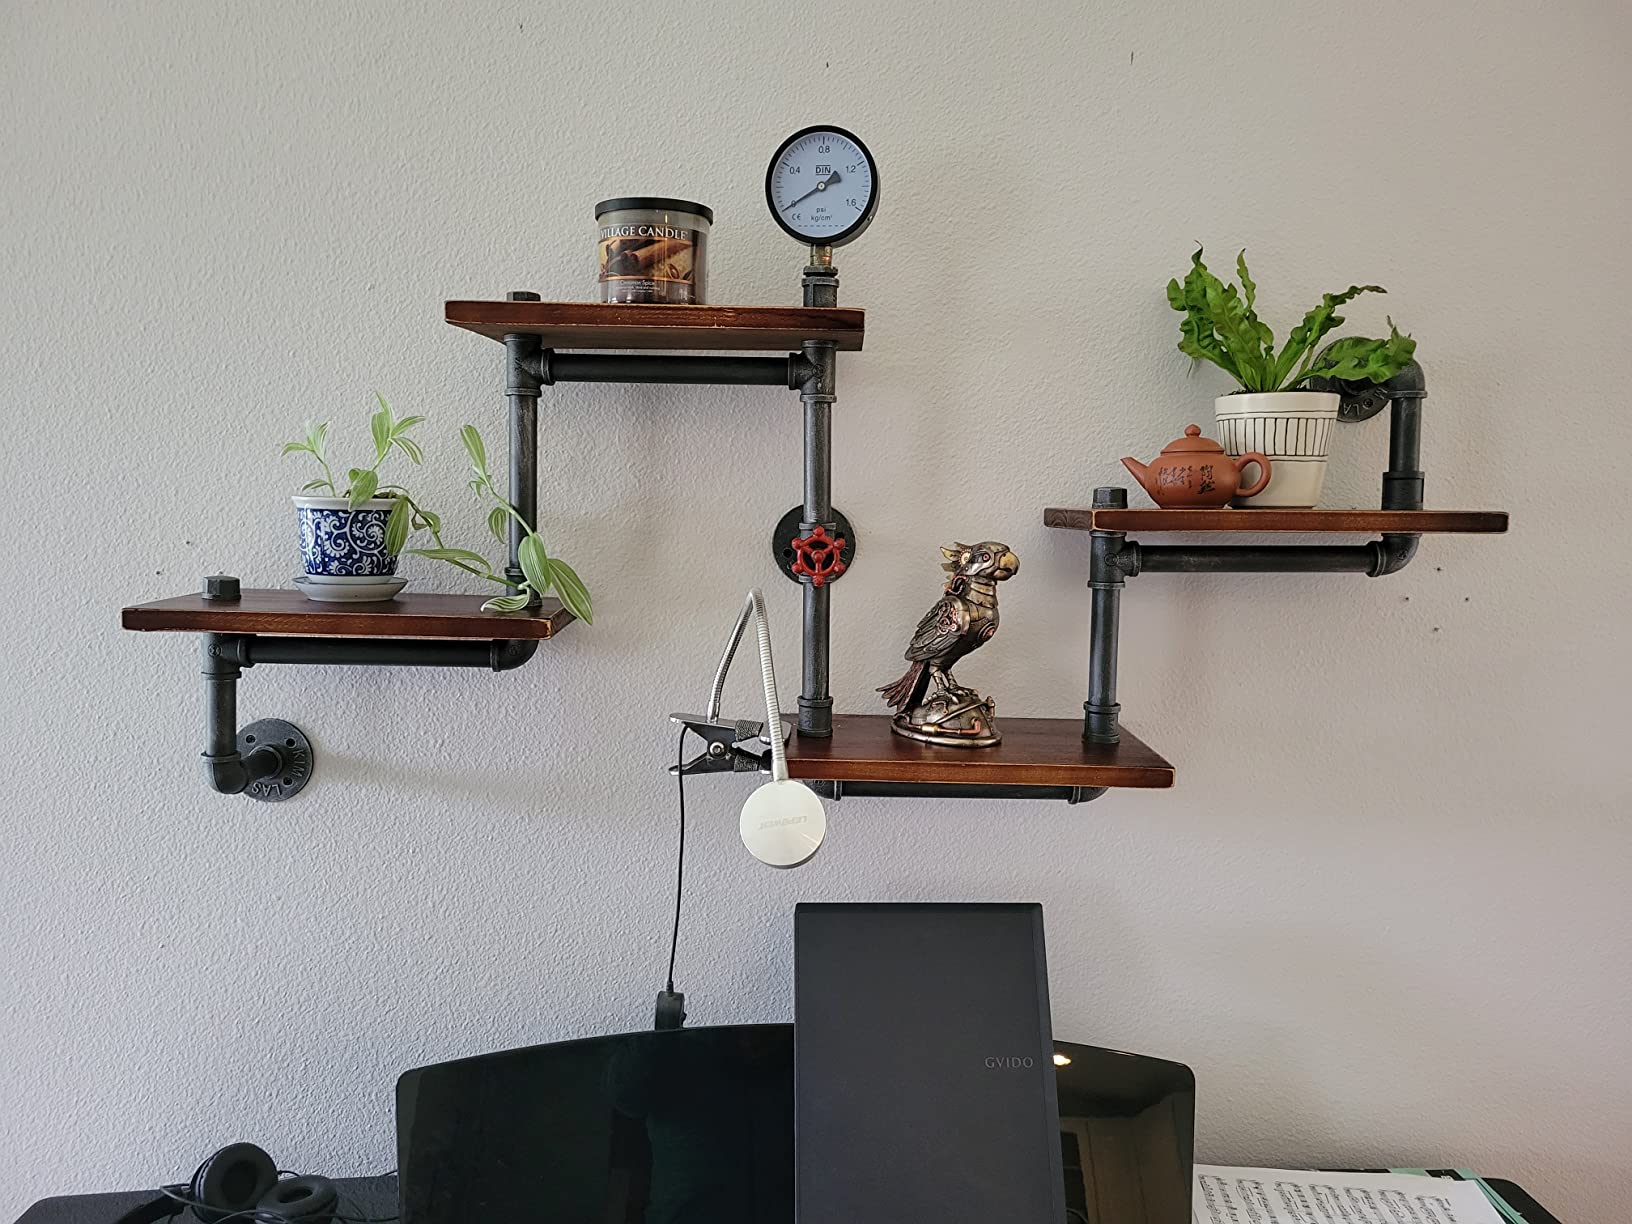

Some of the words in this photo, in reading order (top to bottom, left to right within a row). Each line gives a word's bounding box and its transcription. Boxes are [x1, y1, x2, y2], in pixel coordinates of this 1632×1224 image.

[818, 145, 831, 154] 0.8
[789, 166, 800, 175] 0.4
[816, 165, 831, 175] DIN
[845, 165, 856, 173] 1.2
[845, 198, 857, 207] 1.6
[600, 226, 636, 239] VILLAGE
[638, 226, 689, 240] CANDLE
[1343, 402, 1360, 416] LA
[291, 749, 305, 777] KIM
[251, 782, 282, 797] LAS
[985, 1056, 1033, 1068] GVIDO
